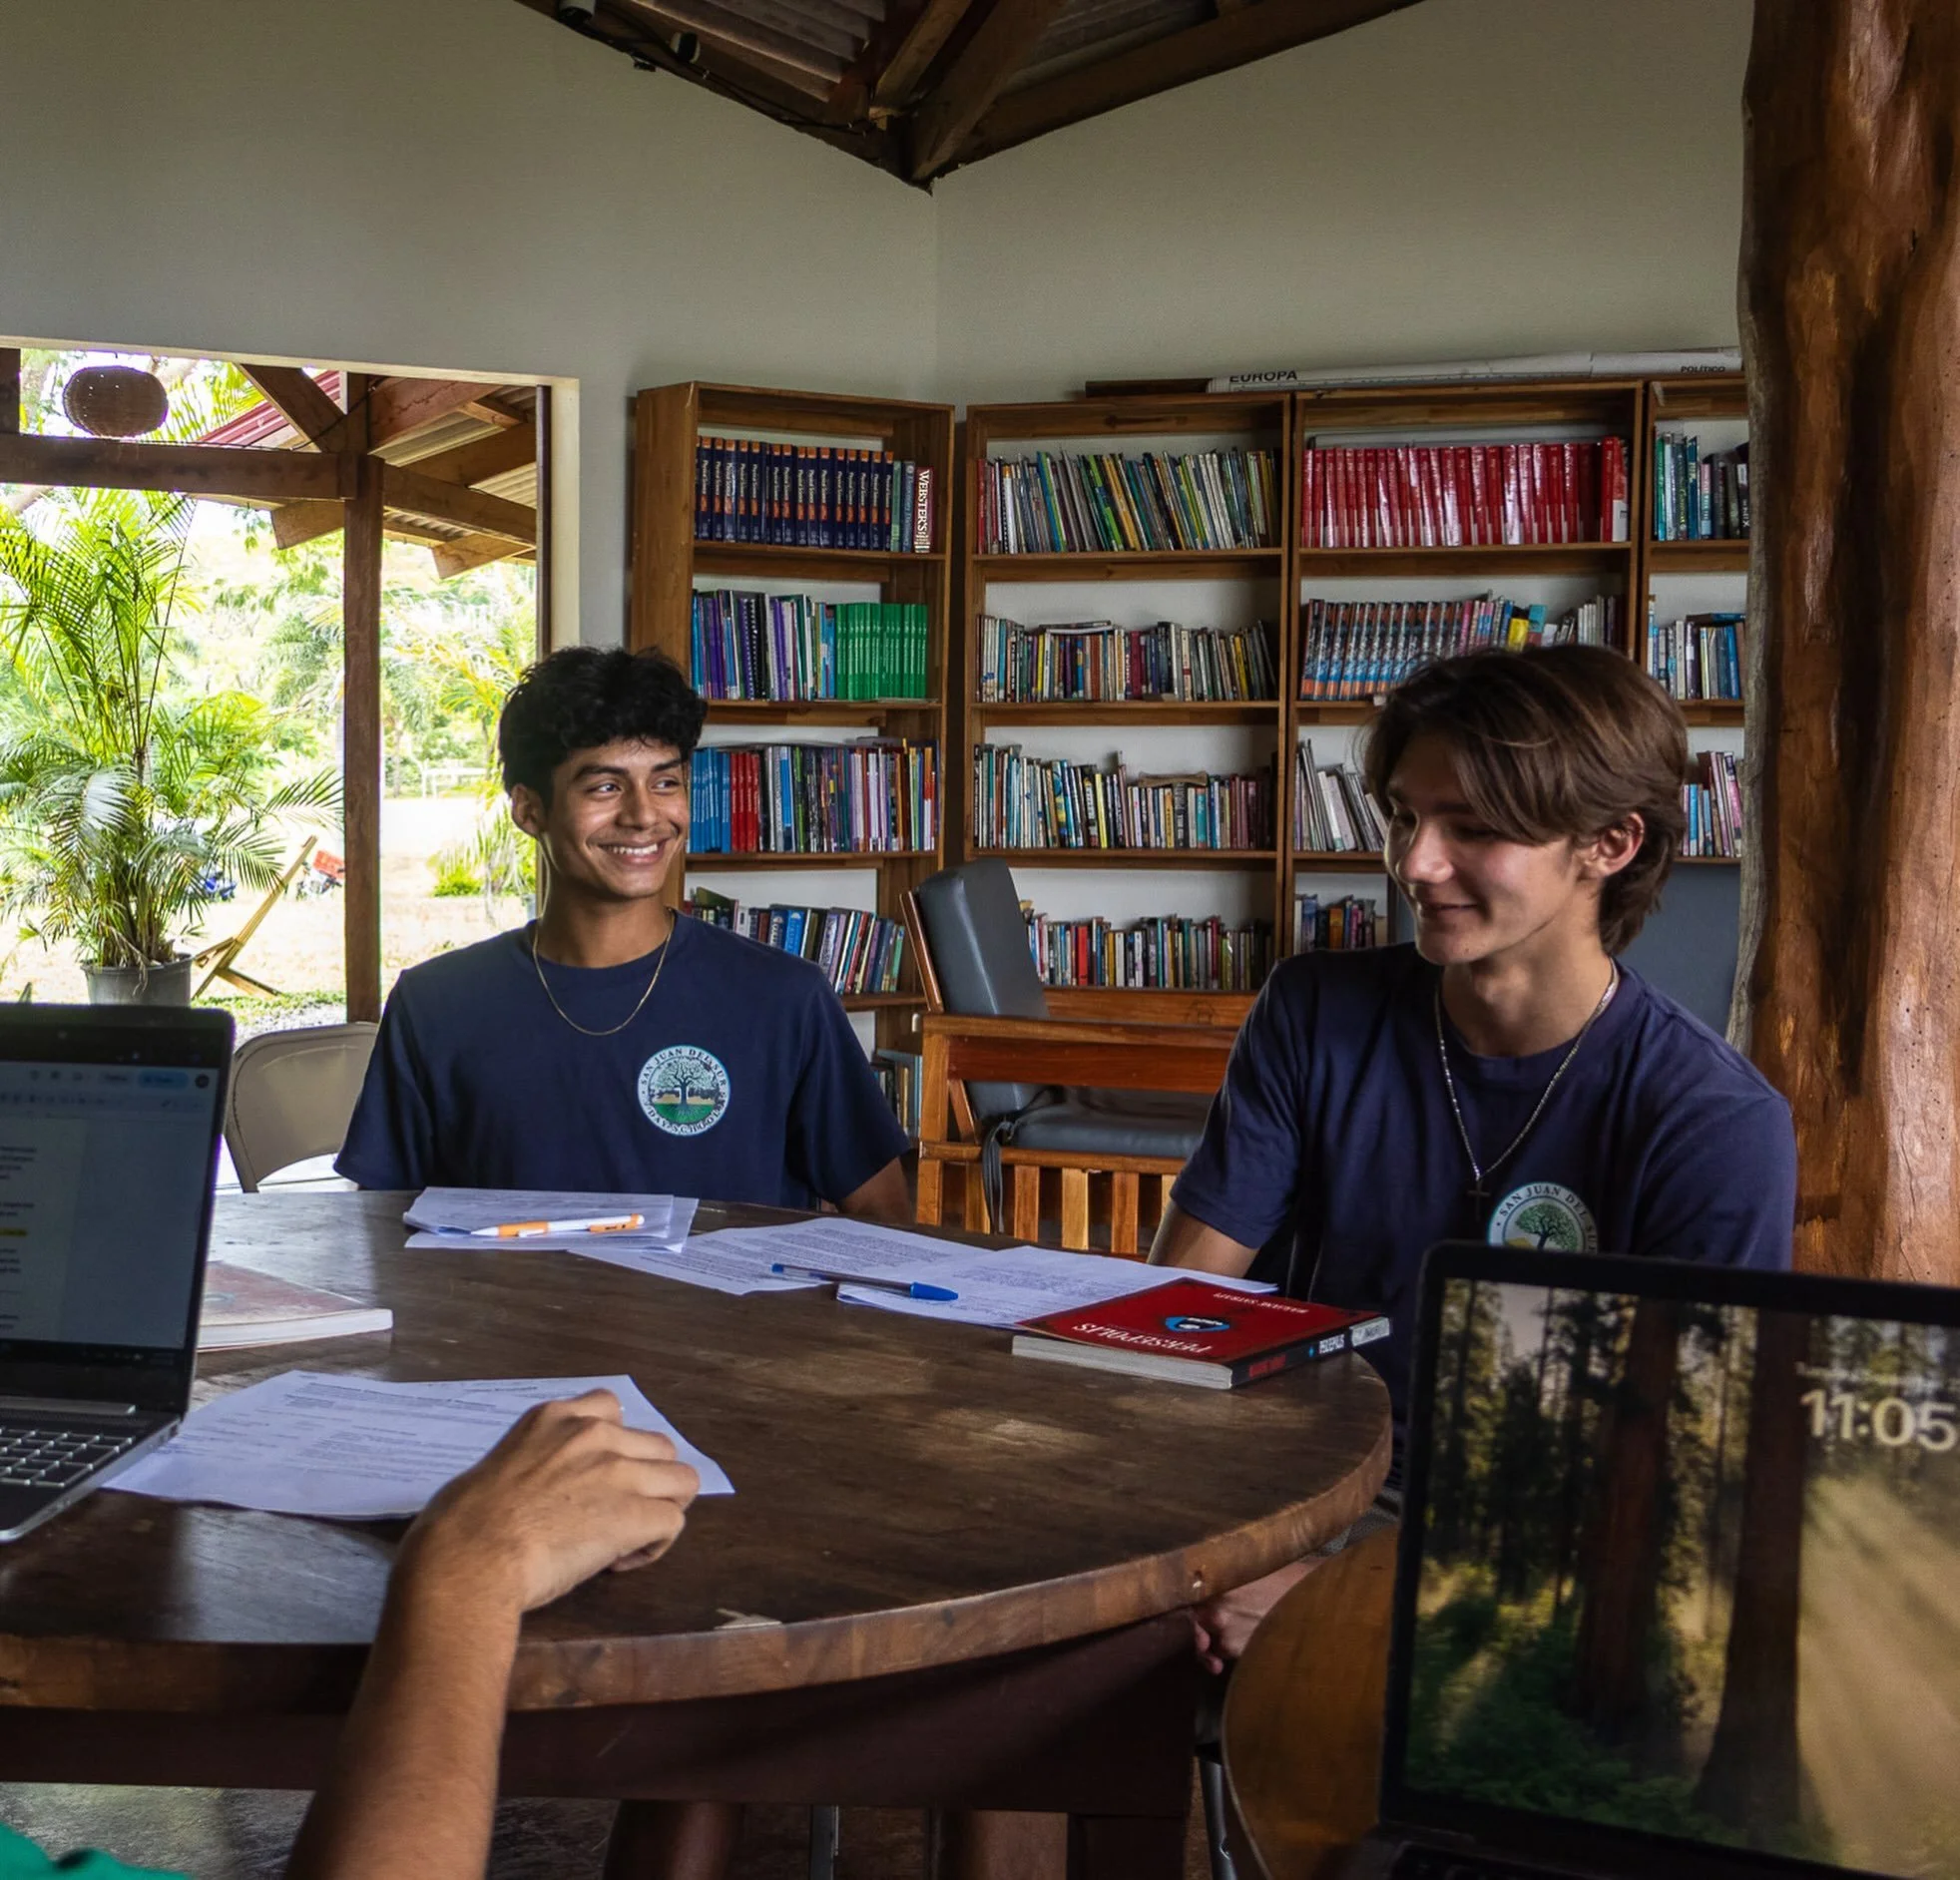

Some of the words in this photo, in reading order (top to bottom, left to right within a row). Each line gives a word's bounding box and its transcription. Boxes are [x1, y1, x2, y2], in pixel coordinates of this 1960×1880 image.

[1228, 369, 1298, 384] EUROPA
[917, 469, 930, 532] WEBSTER'S
[642, 1065, 653, 1085] SAN
[654, 1048, 683, 1065] JUAN
[714, 1064, 728, 1086] SUR
[648, 1108, 668, 1128] DAY
[1499, 1192, 1522, 1216] SAN
[1526, 1184, 1562, 1197] JUAN
[1565, 1193, 1588, 1216] DEL
[1072, 1322, 1213, 1353] PERSEPOLIS
[1799, 1389, 1958, 1452] 11:05
